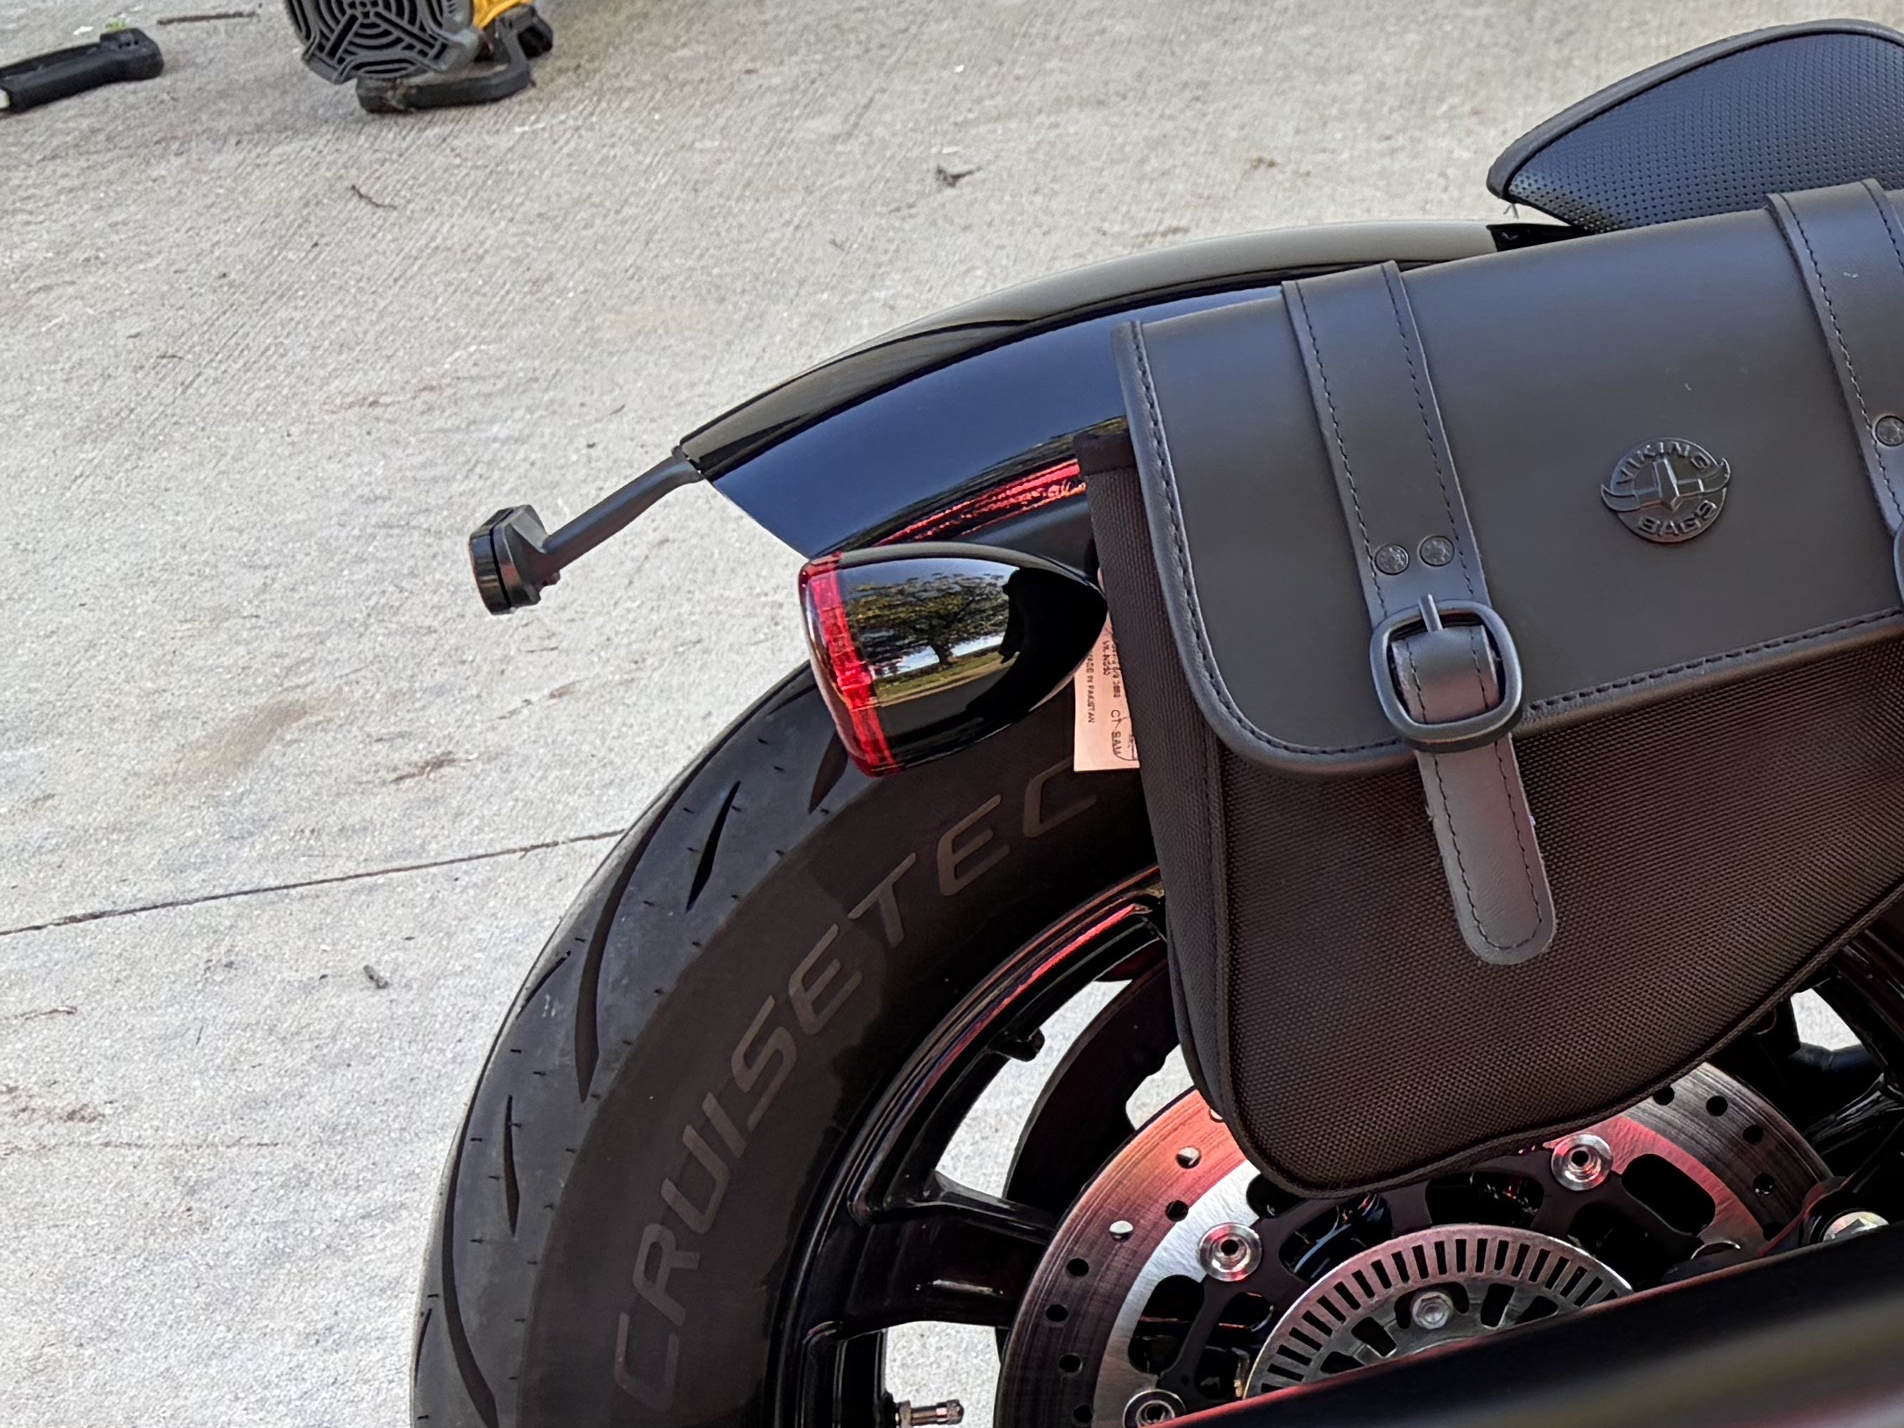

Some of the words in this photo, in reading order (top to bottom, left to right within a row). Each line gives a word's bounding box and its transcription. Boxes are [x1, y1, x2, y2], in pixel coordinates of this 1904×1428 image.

[1615, 441, 1711, 486] VIKING
[1638, 500, 1717, 537] BAGS
[613, 756, 1097, 1413] CRUISETEC
